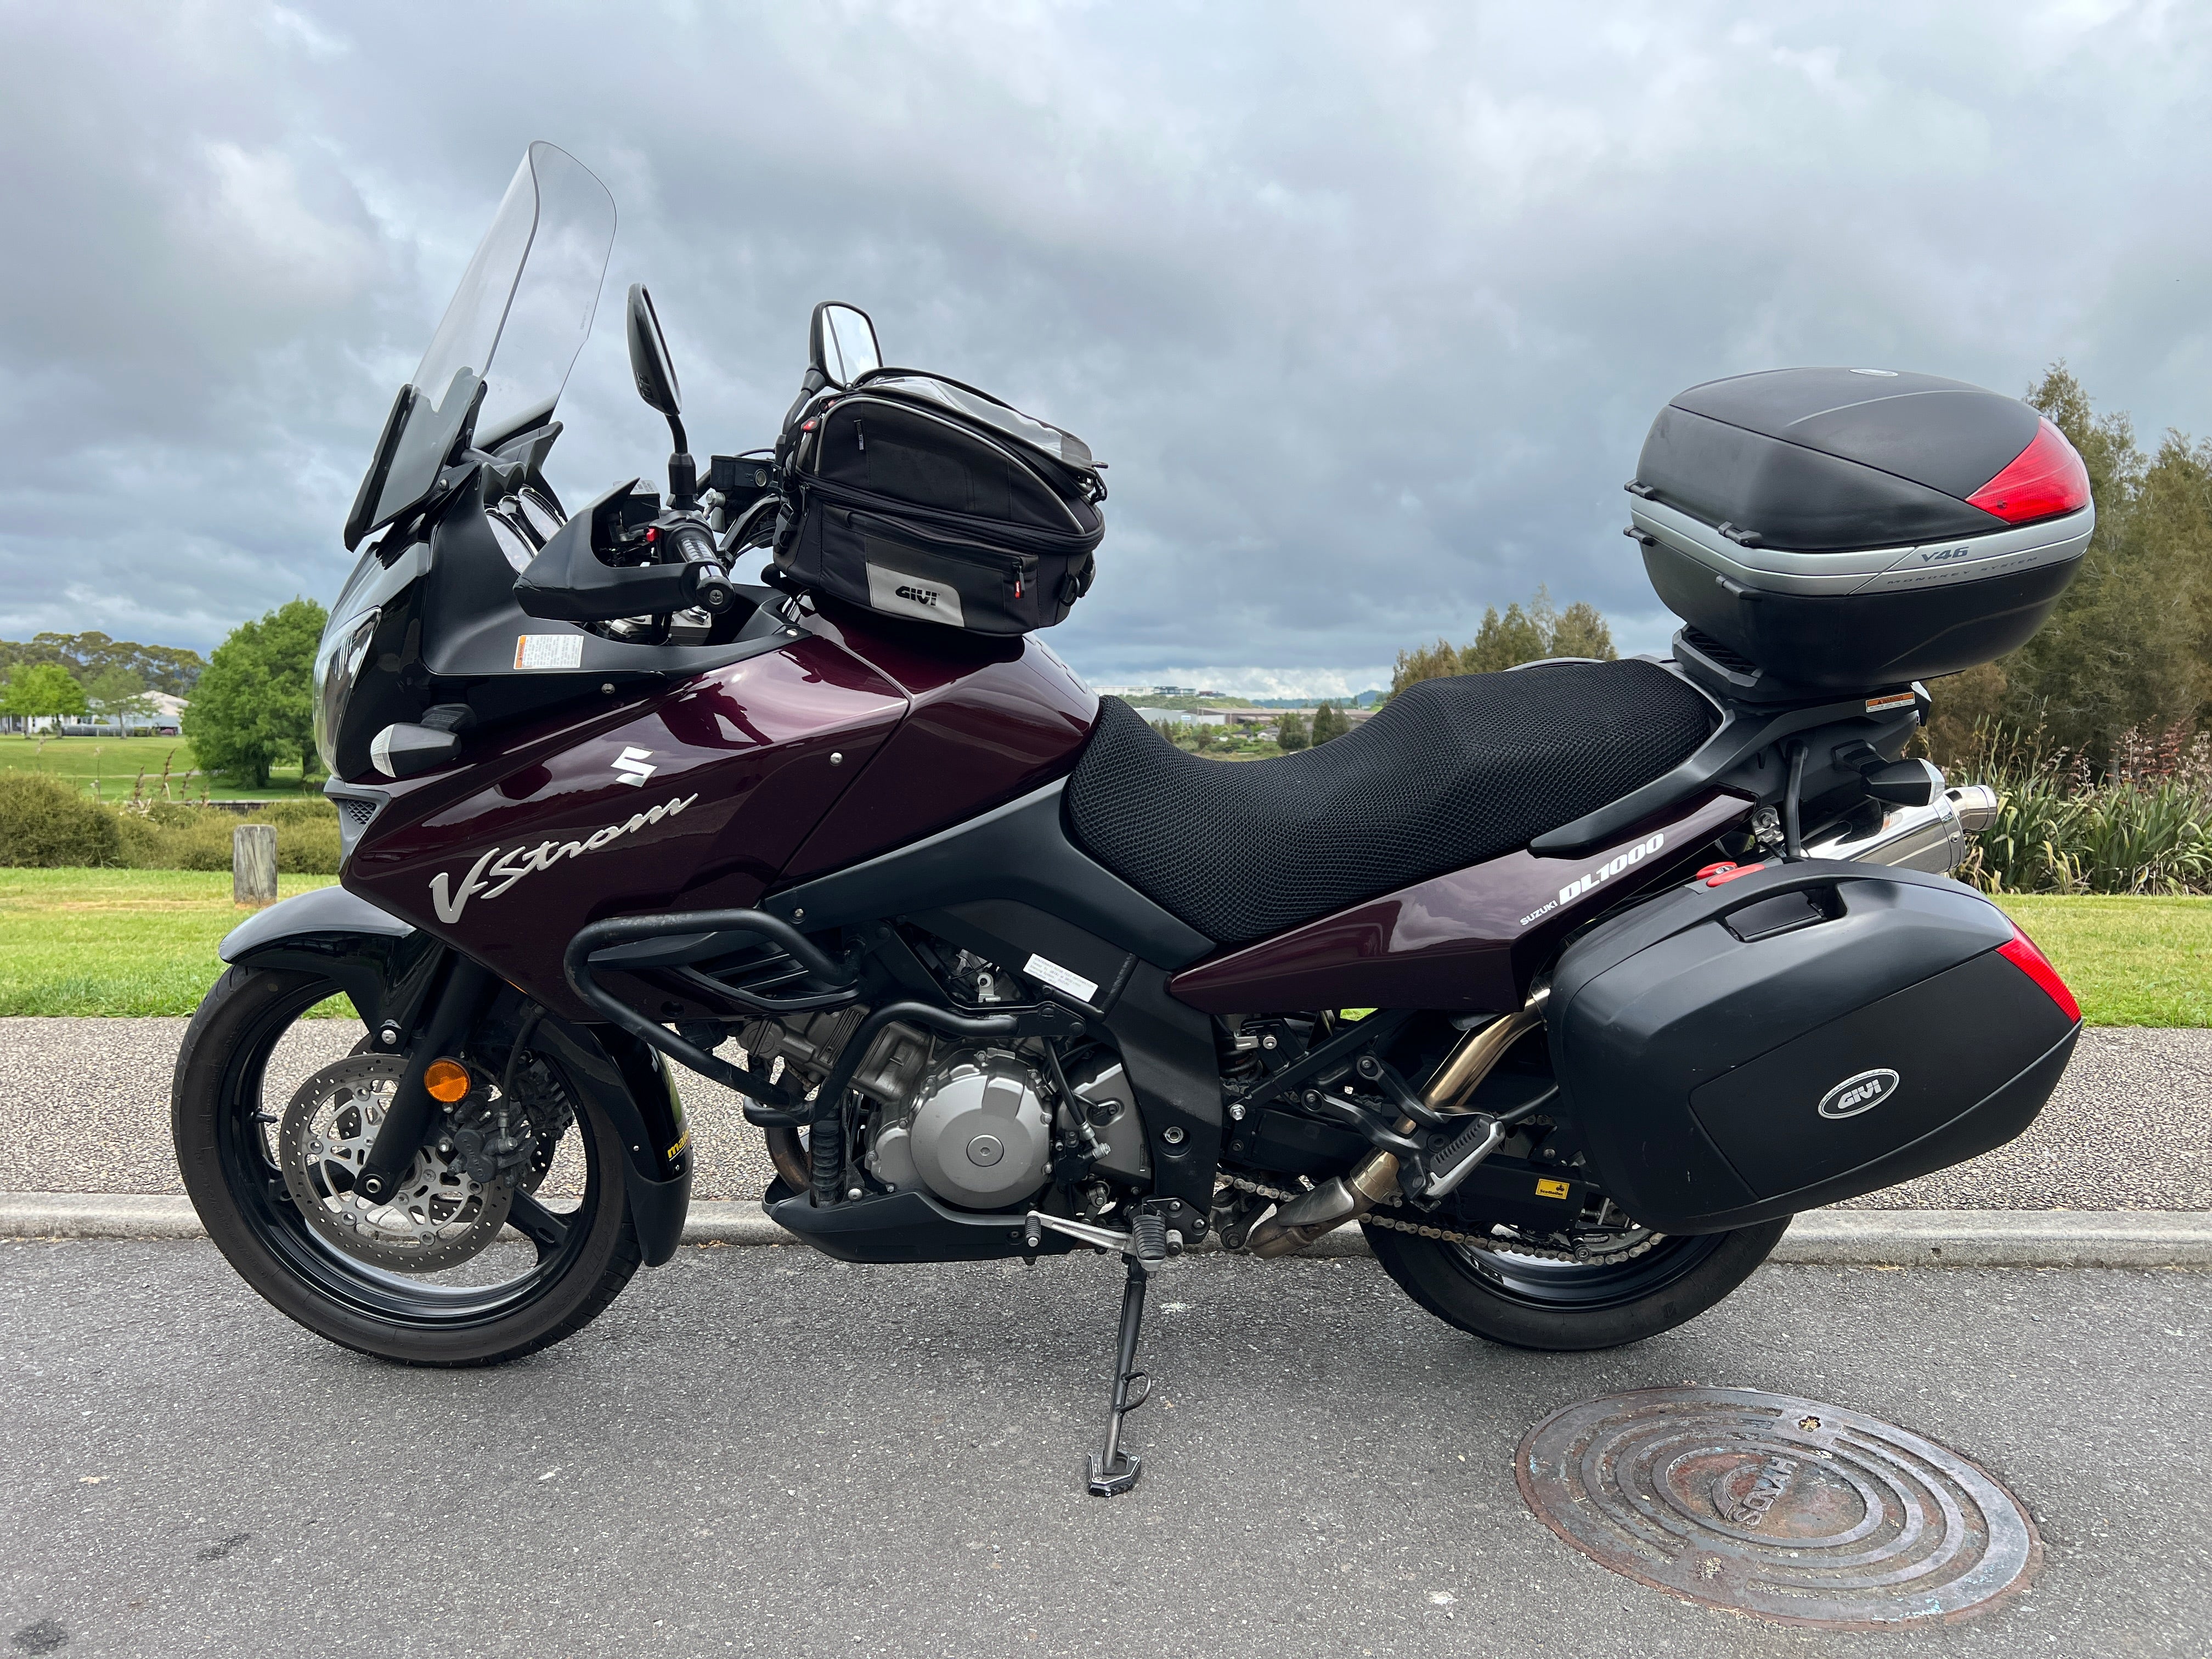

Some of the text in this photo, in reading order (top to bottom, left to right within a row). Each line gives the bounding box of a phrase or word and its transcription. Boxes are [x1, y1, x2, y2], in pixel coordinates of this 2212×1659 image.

[1921, 546, 1969, 562] V46
[1980, 556, 2038, 572] SYSTEM
[895, 585, 938, 606] GIVI
[1519, 832, 1664, 926] SUZUKI DL1000
[1838, 1079, 1882, 1109] GIVI
